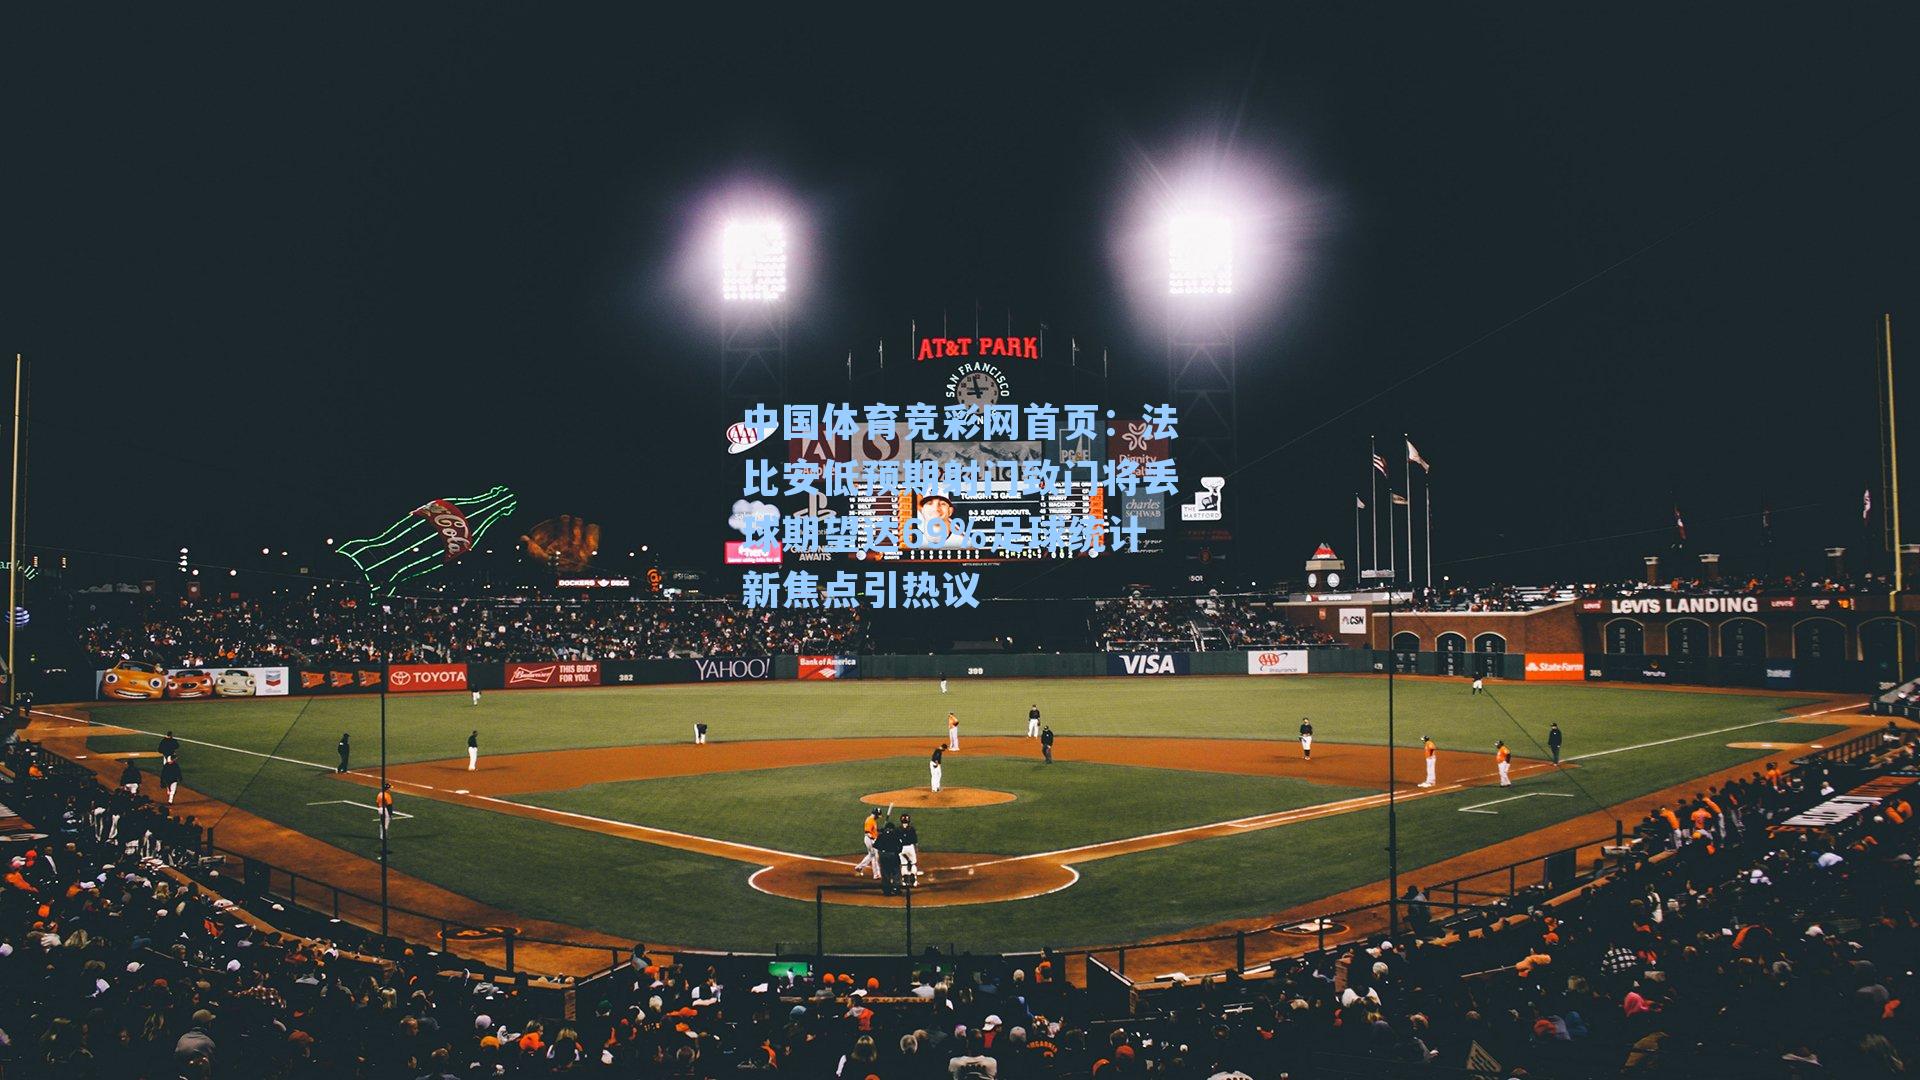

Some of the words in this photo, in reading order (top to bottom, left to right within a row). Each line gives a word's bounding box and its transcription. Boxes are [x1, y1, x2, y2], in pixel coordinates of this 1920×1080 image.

[917, 337, 973, 361] AT&T
[979, 337, 1038, 360] PARK
[945, 374, 960, 398] SAN
[958, 362, 1010, 397] FRANCISCO
[1119, 455, 1157, 464] Dignity
[1125, 499, 1160, 509] charles
[1125, 510, 1161, 518] SCHWAB
[799, 553, 832, 561] AWAITS
[558, 579, 595, 587] DOCKERS
[610, 579, 629, 587] DECK
[1665, 597, 1758, 613] LANDING
[1350, 616, 1364, 625] CSN
[800, 657, 818, 666] Bank
[818, 657, 826, 666] of
[825, 657, 856, 666] America
[1119, 654, 1175, 674] VISA
[559, 665, 575, 673] THIS
[577, 664, 597, 673] BUD'S
[695, 658, 770, 681] YAHOO!
[413, 671, 466, 683] TOYOTA
[514, 669, 551, 680] Budweiser
[574, 674, 590, 682] YOU.
